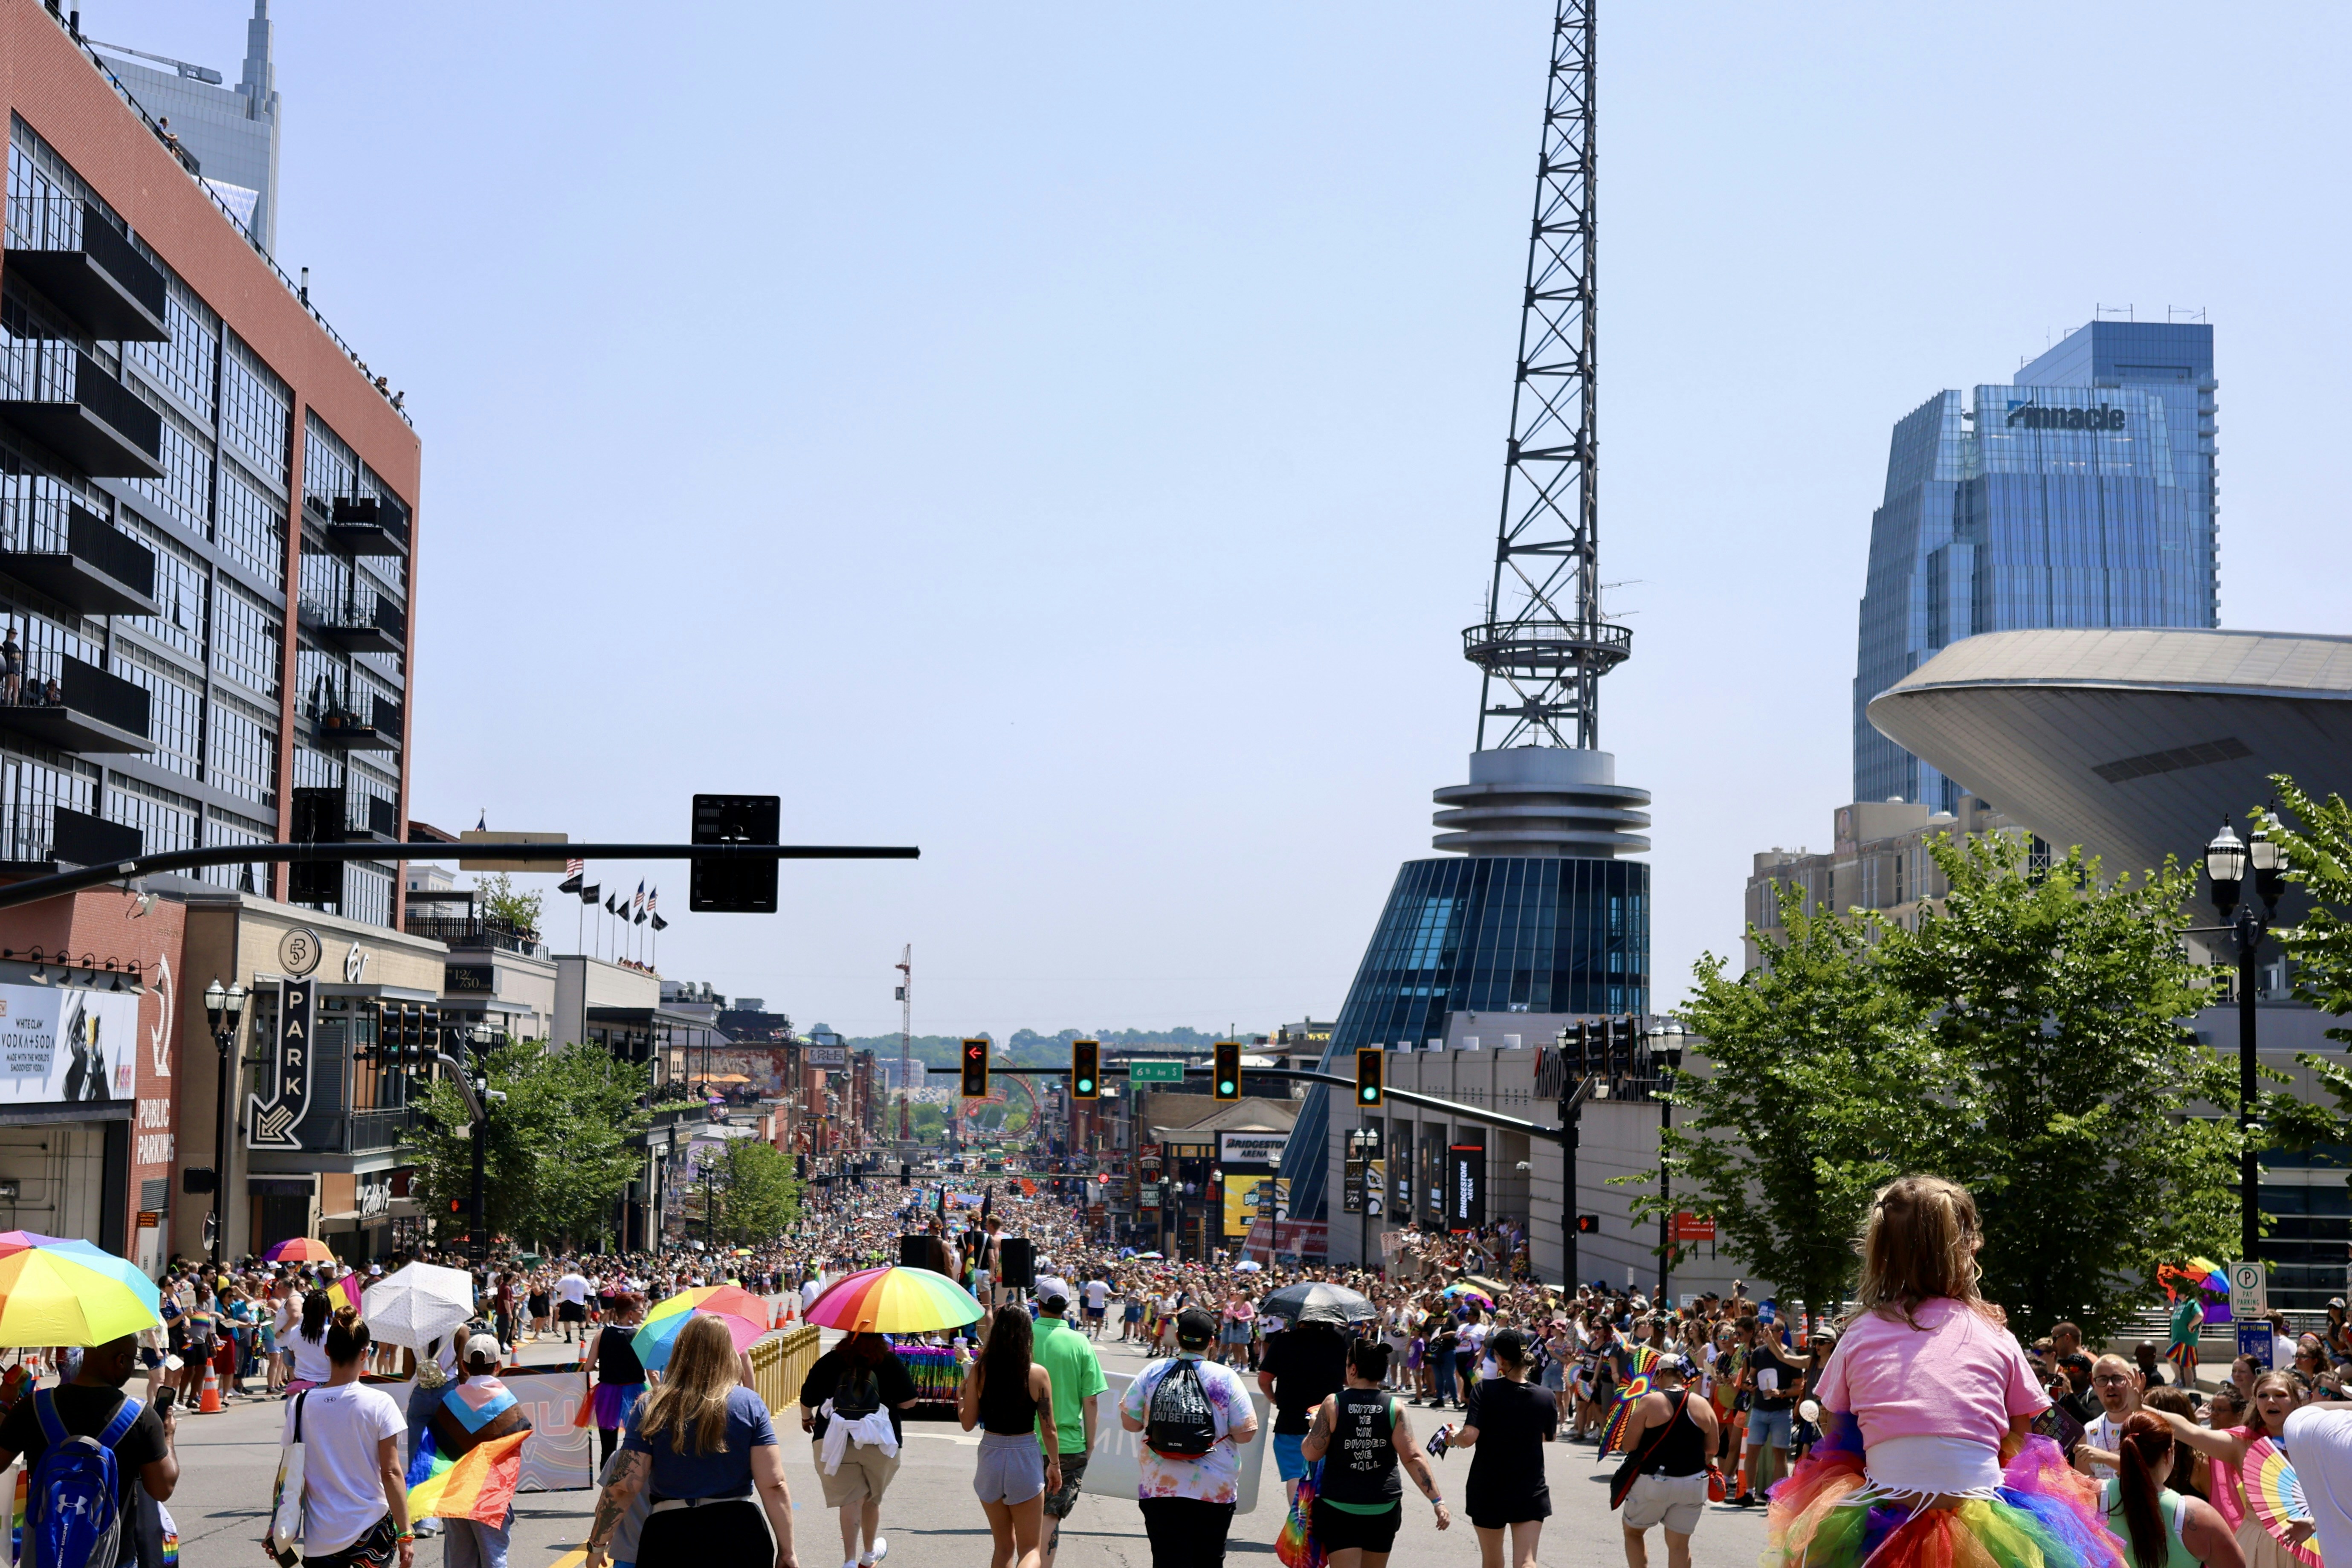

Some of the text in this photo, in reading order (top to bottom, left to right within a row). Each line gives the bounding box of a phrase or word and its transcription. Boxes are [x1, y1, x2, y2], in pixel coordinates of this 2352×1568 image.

[2007, 400, 2125, 430] Pinnacle
[16, 1018, 43, 1029] WHITE CLAW
[286, 991, 304, 1095] PARK
[1172, 1068, 1177, 1076] S
[139, 1099, 170, 1129] PUBLIC
[137, 1133, 174, 1165] PARKING
[1141, 1160, 1160, 1168] RIBS
[1141, 1191, 1159, 1199] HONKY
[1460, 1160, 1468, 1219] BRIDGESTONE
[2245, 1272, 2251, 1285] P
[1154, 1402, 1162, 1411] TO
[1348, 1404, 1383, 1414] UNITED
[1168, 1412, 1206, 1425] BETTER.
[1359, 1415, 1371, 1425] WE
[1356, 1426, 1372, 1438] WIN
[1344, 1438, 1386, 1449] DIVIDED
[1354, 1450, 1372, 1460] WE
[1350, 1461, 1381, 1471] FALL
